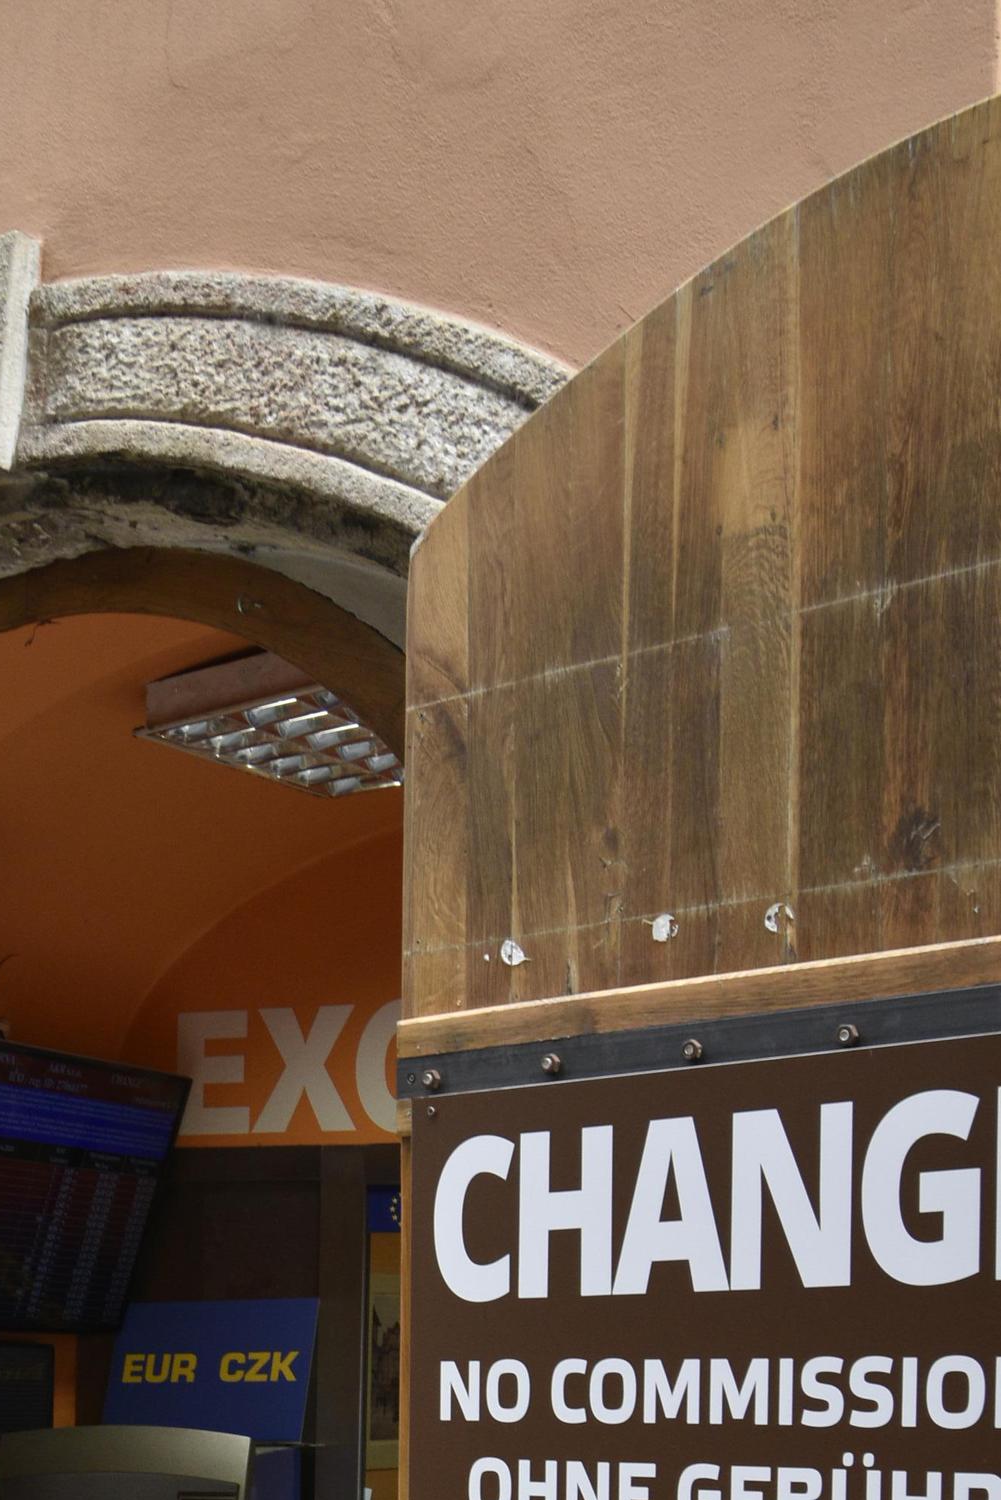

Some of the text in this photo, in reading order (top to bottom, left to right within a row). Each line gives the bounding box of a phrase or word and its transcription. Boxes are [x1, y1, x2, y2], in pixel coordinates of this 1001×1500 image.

[434, 1087, 1001, 1302] CHANG
[122, 1350, 299, 1385] EUR CZK
[440, 1355, 1001, 1429] NO COMMISSIO
